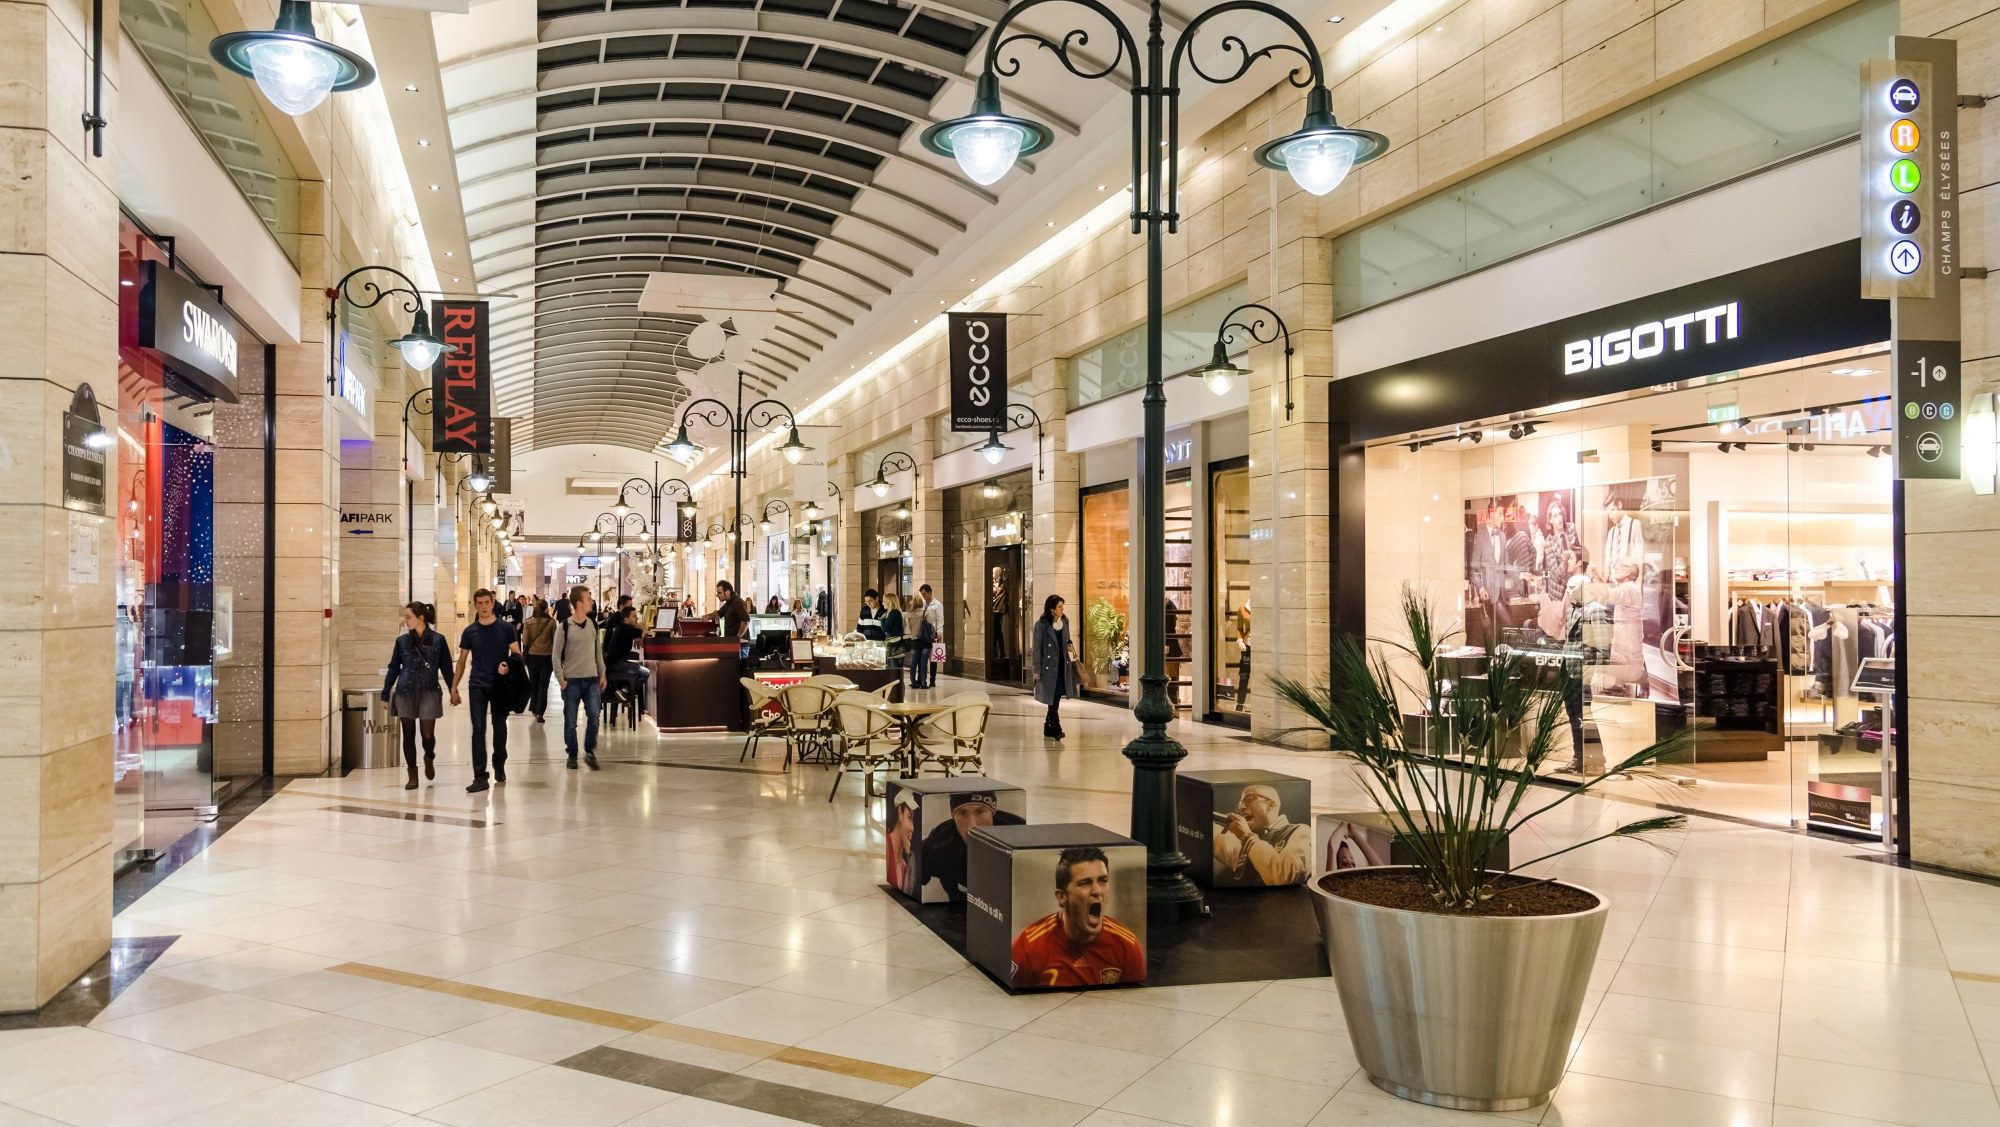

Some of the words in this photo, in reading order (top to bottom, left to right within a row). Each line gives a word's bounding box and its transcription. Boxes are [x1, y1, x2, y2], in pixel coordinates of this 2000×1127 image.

[1898, 125, 1914, 147] R
[1939, 130, 1951, 200] ÉLYSÉES
[1900, 165, 1913, 188] L
[1941, 209, 1951, 275] CHAMPS
[968, 321, 991, 407] ecco
[1564, 301, 1741, 376] BIGOTTI
[443, 306, 477, 449] REPLAY
[1911, 356, 1926, 388] -1
[340, 513, 393, 523] AFIPARK
